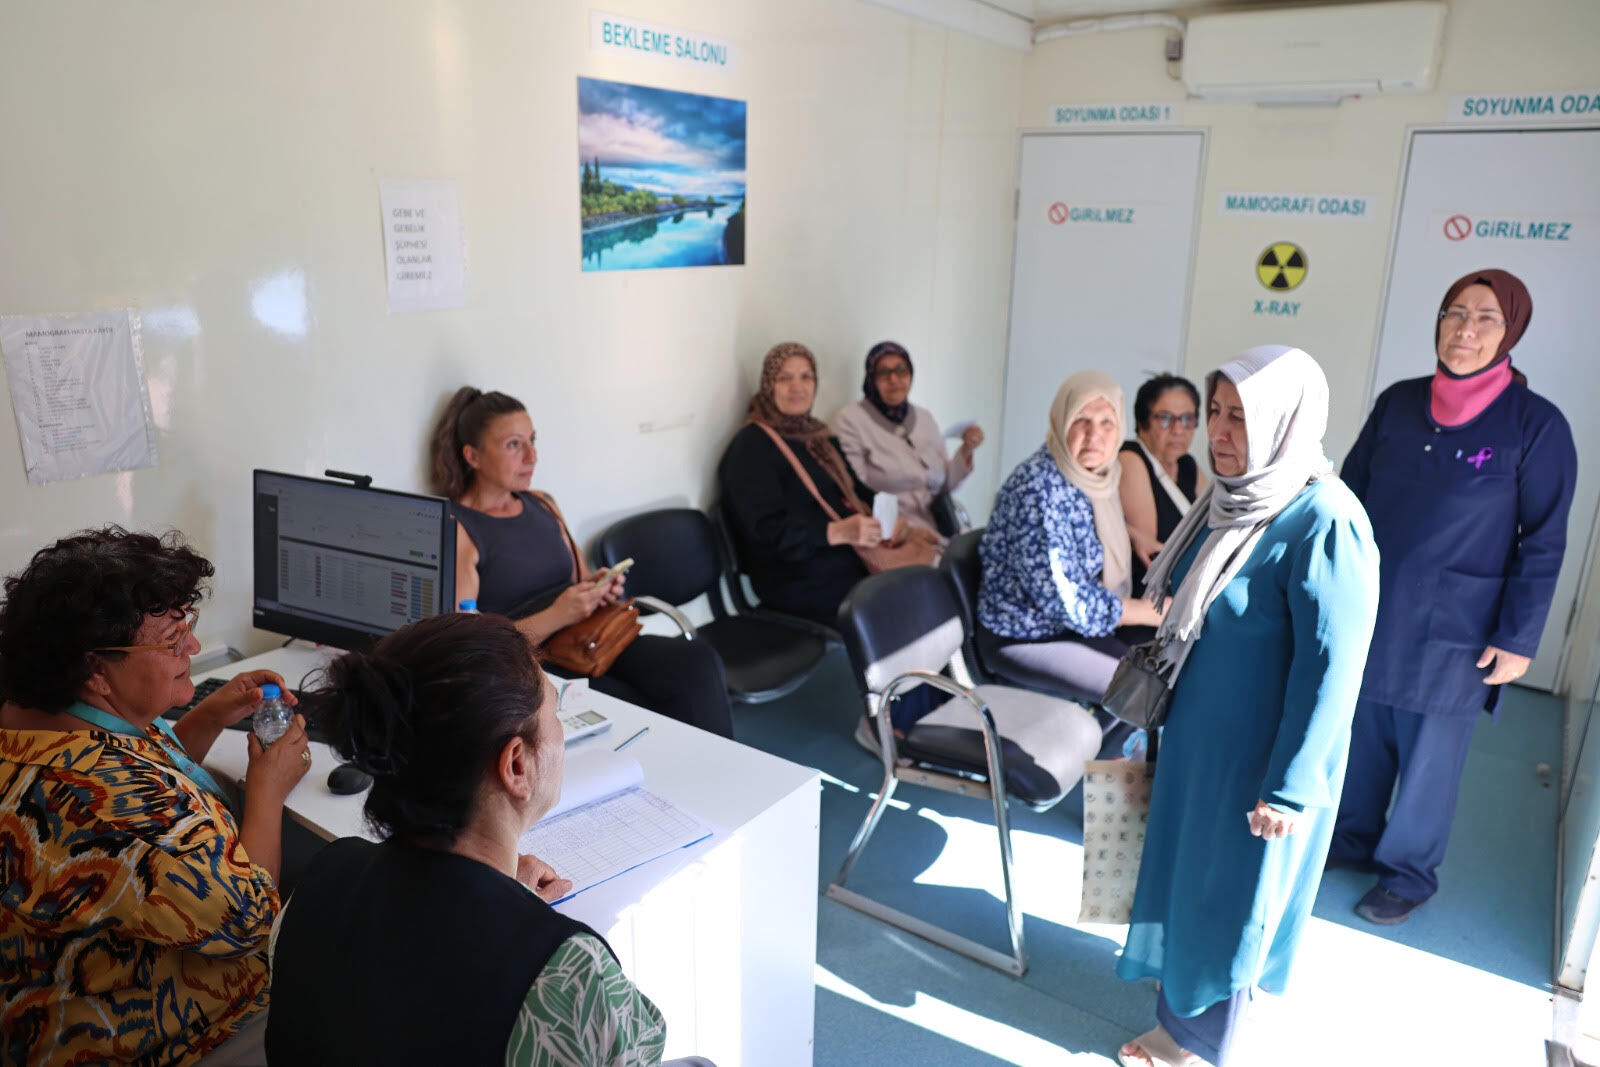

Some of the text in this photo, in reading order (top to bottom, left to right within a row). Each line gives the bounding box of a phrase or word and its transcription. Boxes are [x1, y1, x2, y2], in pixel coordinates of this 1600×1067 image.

[602, 21, 728, 66] BEKLEME SALONU
[1055, 105, 1171, 123] SOYUNMA ODASI 1
[1462, 96, 1555, 117] SOYUNMA
[1317, 197, 1367, 215] ODASI
[1254, 300, 1301, 316] X-RAY
